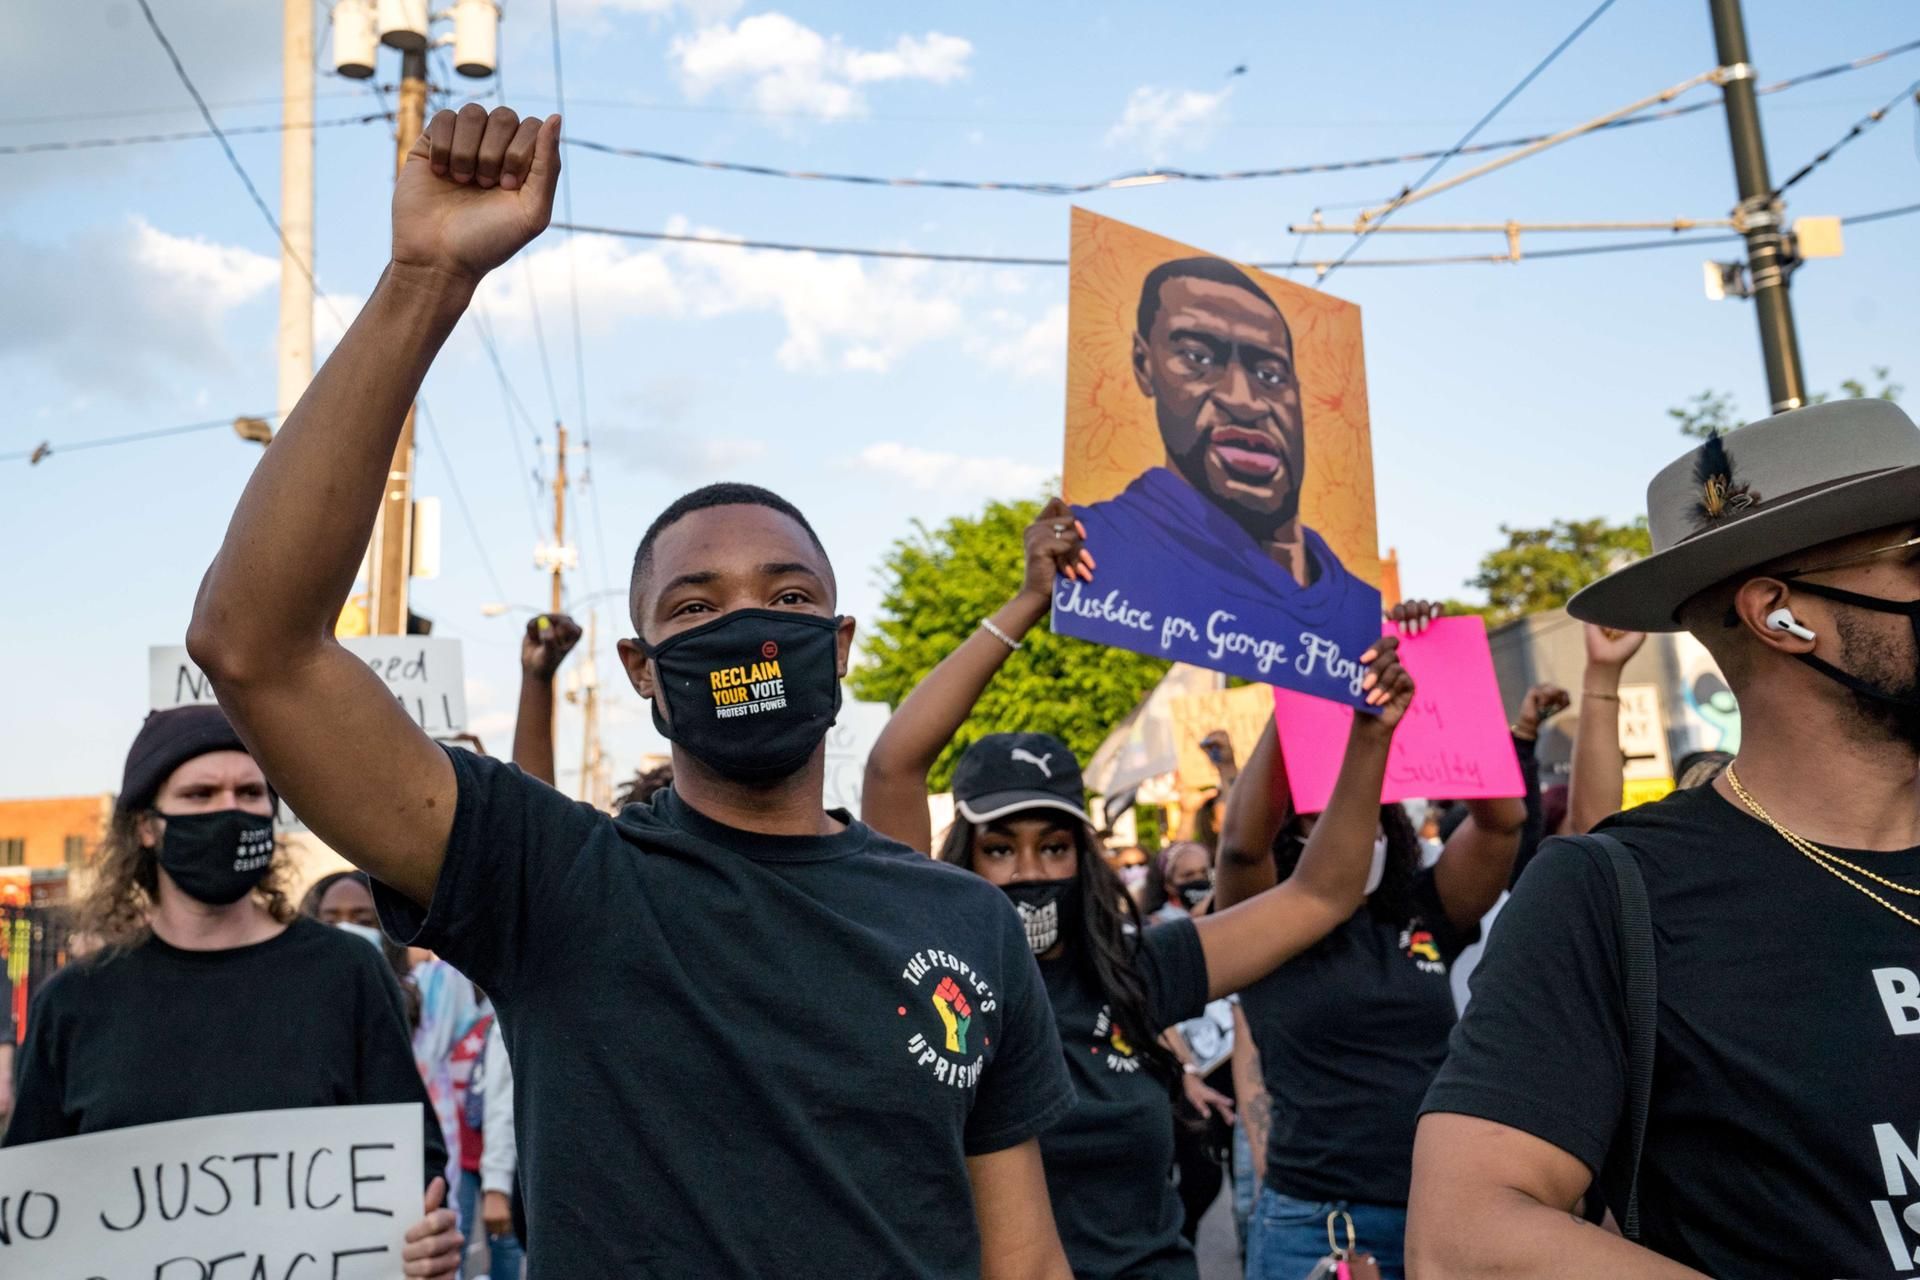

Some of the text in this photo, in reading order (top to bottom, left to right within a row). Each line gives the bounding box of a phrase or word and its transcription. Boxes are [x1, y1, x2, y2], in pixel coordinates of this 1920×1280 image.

[1055, 578, 1370, 697] Justice for George Floy
[369, 649, 428, 683] eed
[710, 660, 782, 690] RECLAIM
[712, 679, 785, 706] YOUR VOTE
[716, 698, 787, 719] PROTEST TO POWER
[902, 948, 997, 1013] THE PEOPLE'S
[907, 1032, 984, 1089] UPRISING
[99, 1143, 395, 1232] JUSTICE
